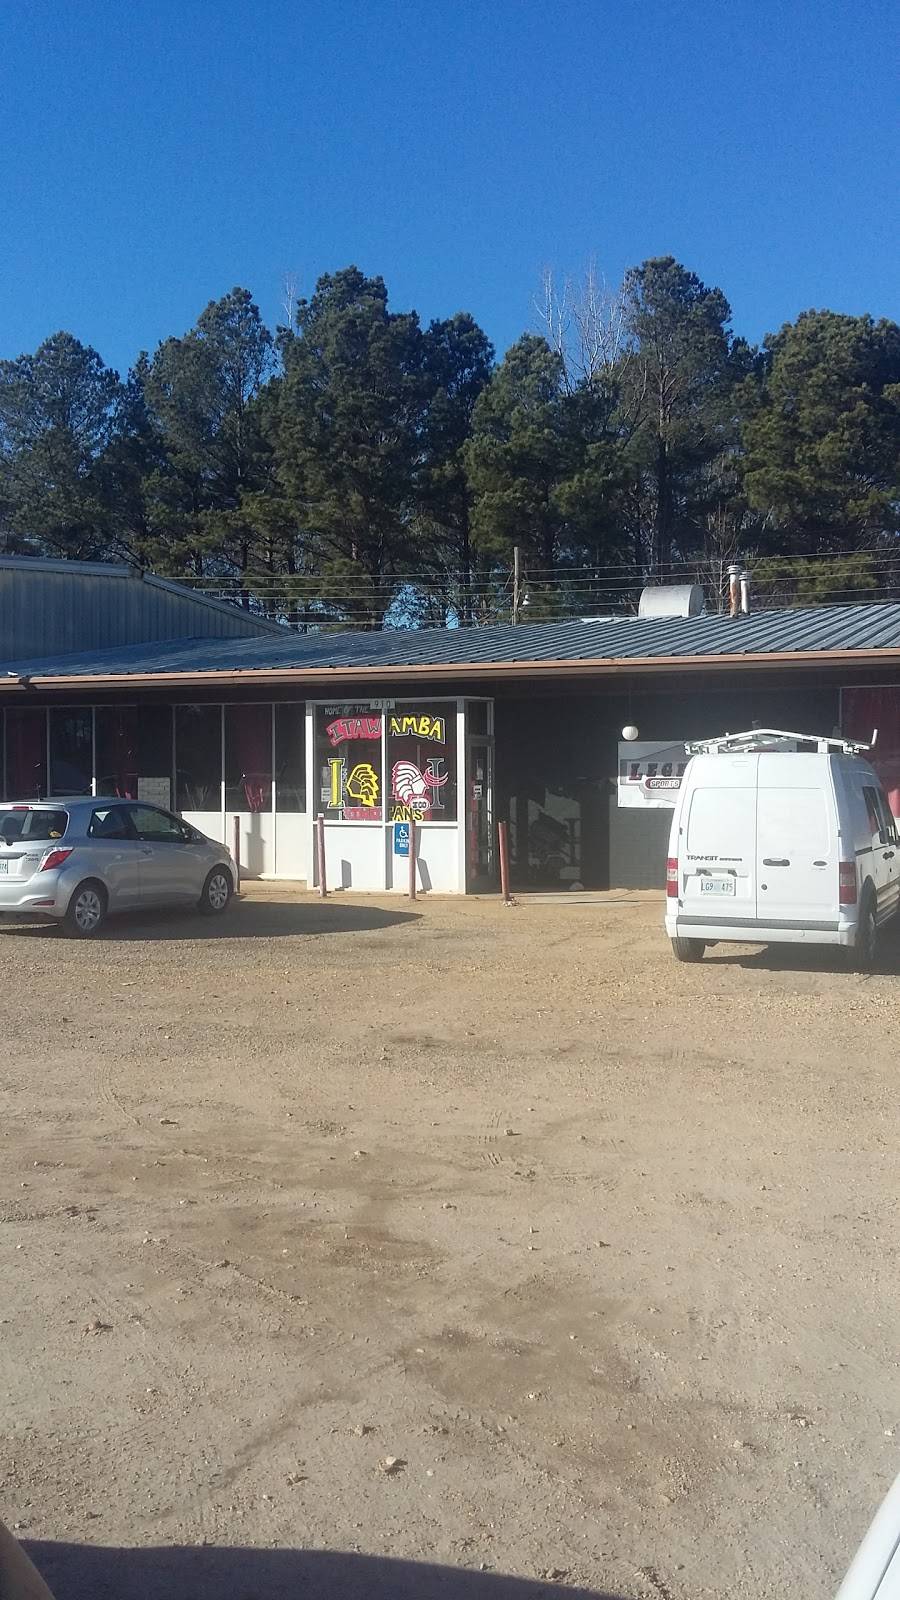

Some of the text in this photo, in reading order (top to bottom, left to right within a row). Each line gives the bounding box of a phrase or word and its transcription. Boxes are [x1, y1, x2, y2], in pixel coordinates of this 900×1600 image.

[325, 706, 342, 716] HOME
[355, 705, 369, 714] THE
[651, 780, 679, 788] SPORTS
